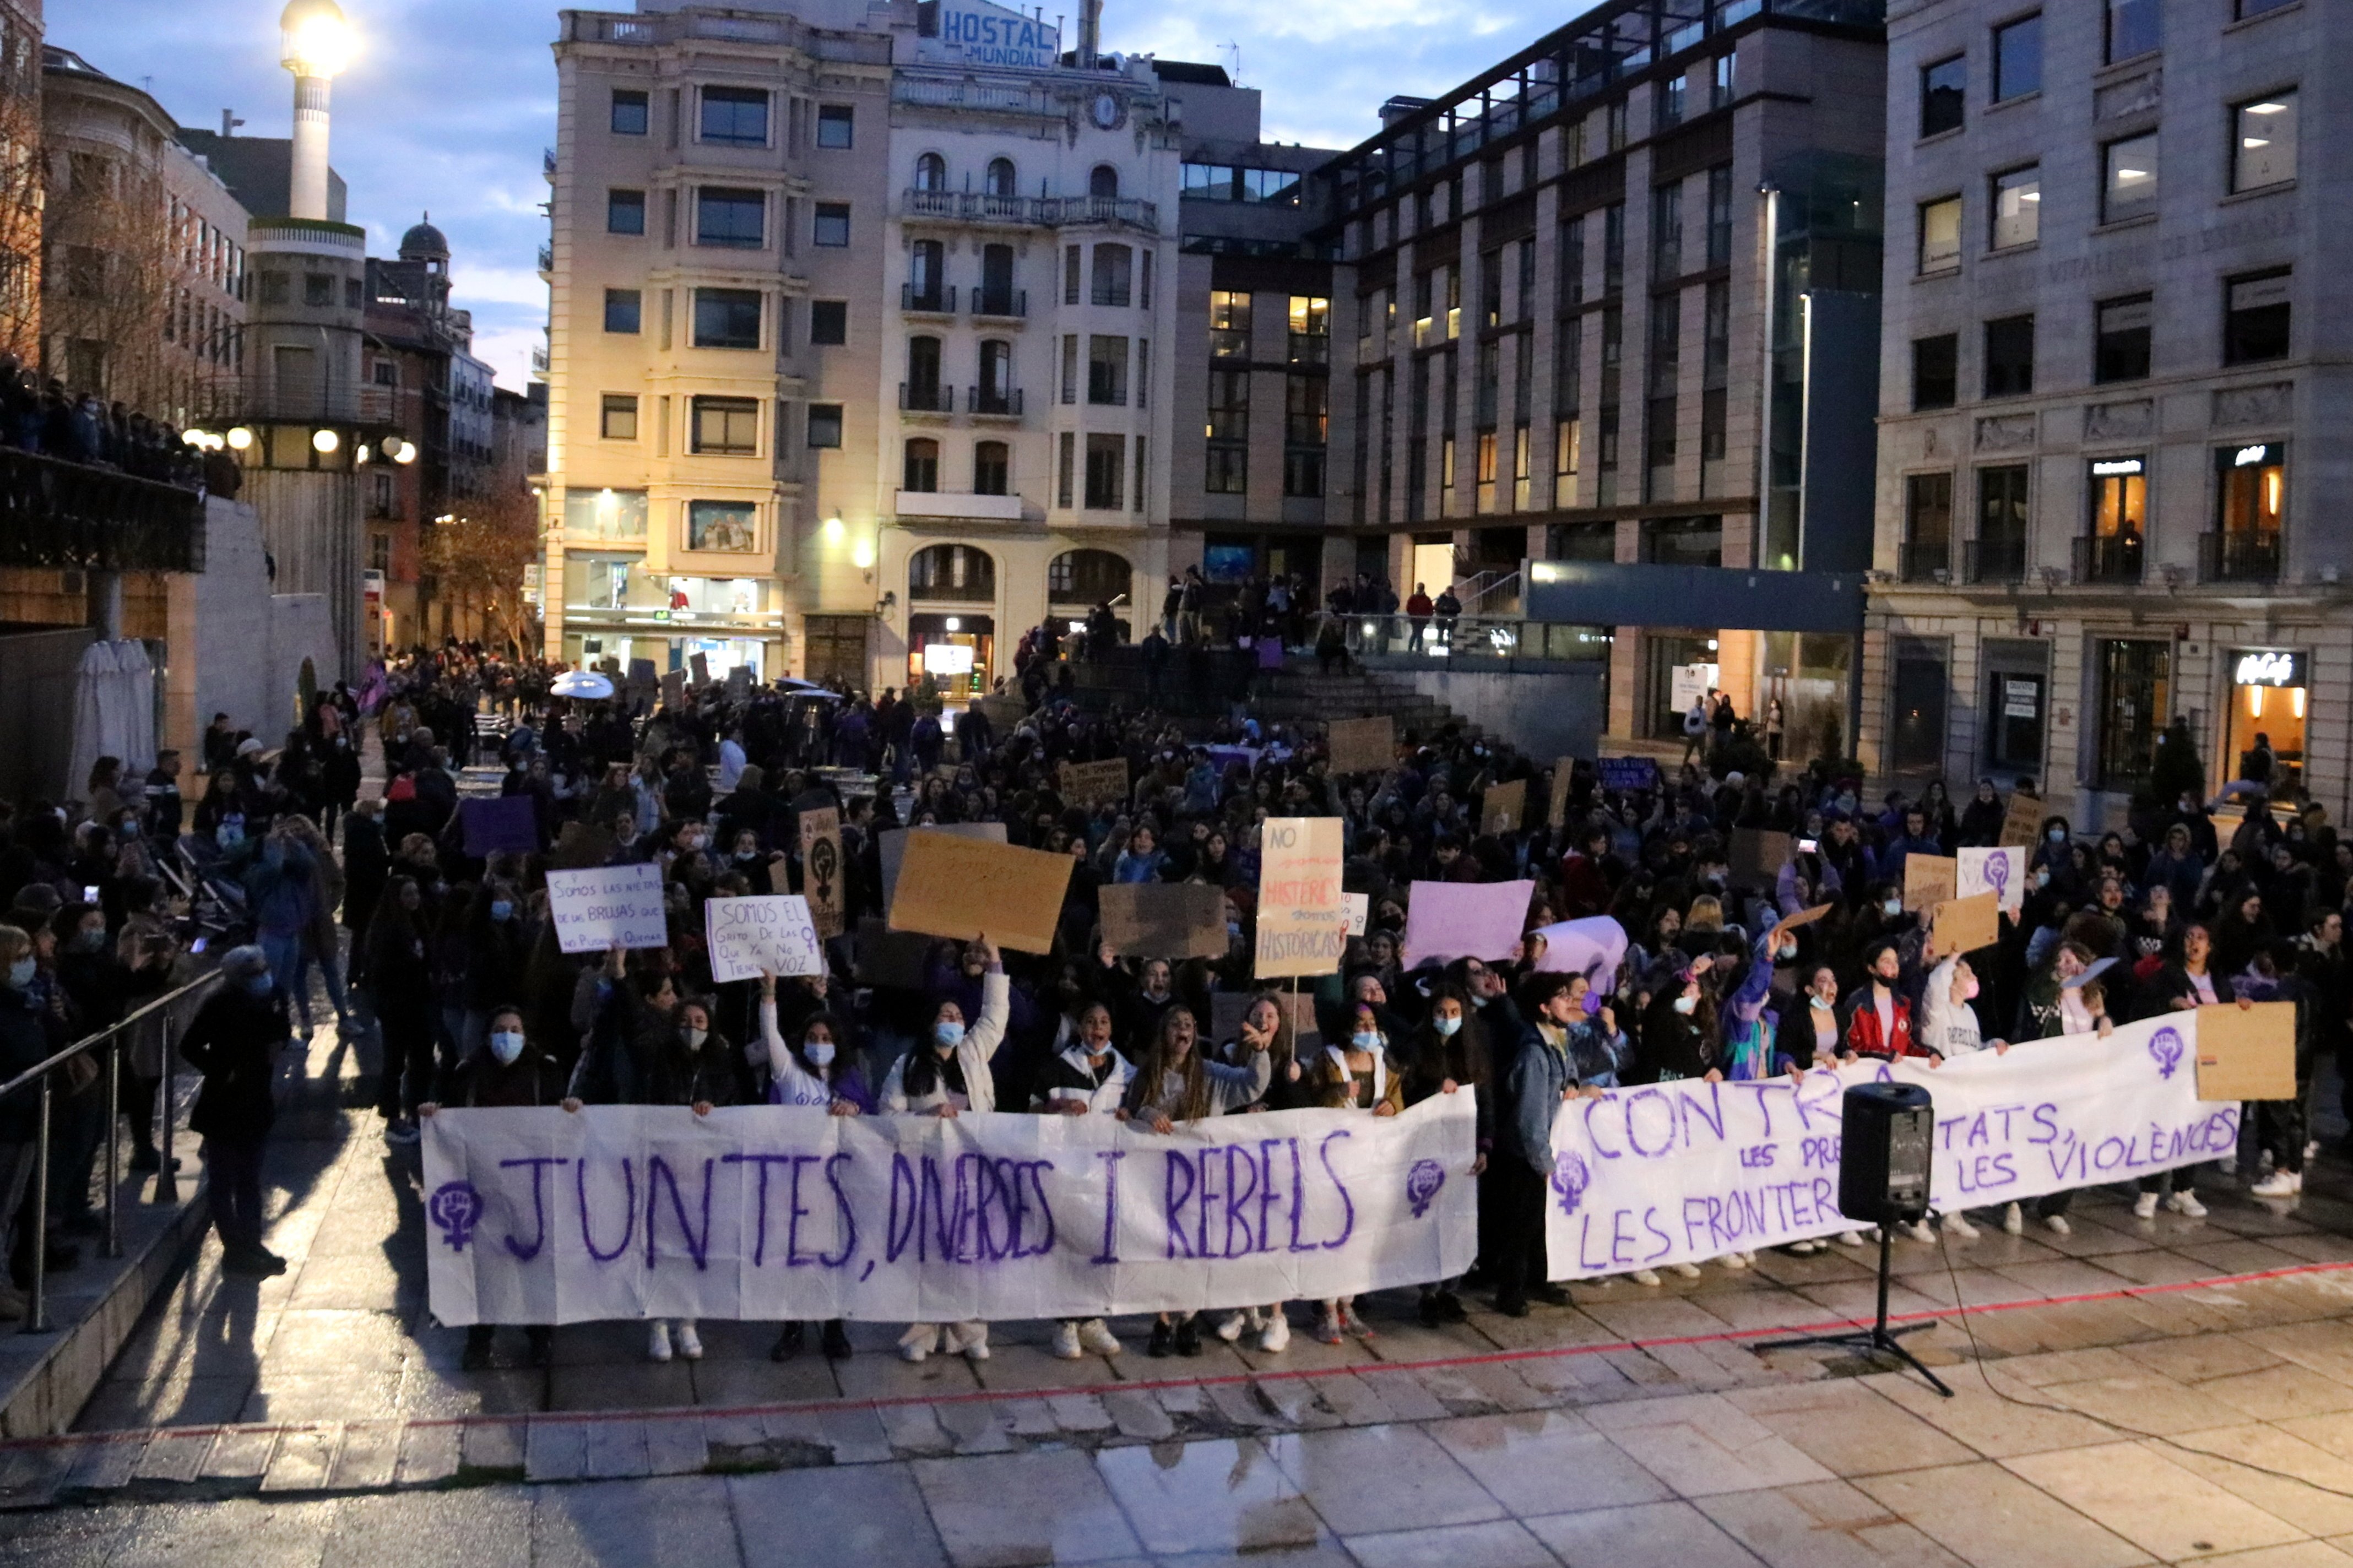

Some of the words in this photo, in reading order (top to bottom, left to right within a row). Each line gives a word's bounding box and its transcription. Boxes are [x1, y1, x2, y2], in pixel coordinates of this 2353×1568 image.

[945, 10, 1053, 51] HOSTAL
[970, 45, 1048, 68] MUNDIAL
[1270, 827, 1297, 849] NO
[603, 883, 622, 894] LAS
[626, 880, 661, 892] NIETAS
[587, 903, 635, 921] BRUJAS
[722, 902, 777, 925] SOMOS
[783, 901, 804, 921] EL
[1259, 927, 1340, 962] HISTÓRICAS
[775, 955, 806, 973] VOZ
[1740, 1143, 1779, 1168] LES
[1580, 1206, 1671, 1269] LES
[1958, 1153, 2017, 1192] LES
[2048, 1107, 2237, 1181] VIOLÈNCIES
[500, 1152, 876, 1282] JUNTES,
[886, 1151, 1055, 1264] DIVERSES
[1090, 1151, 1125, 1265] I
[1165, 1129, 1354, 1260] REBELS
